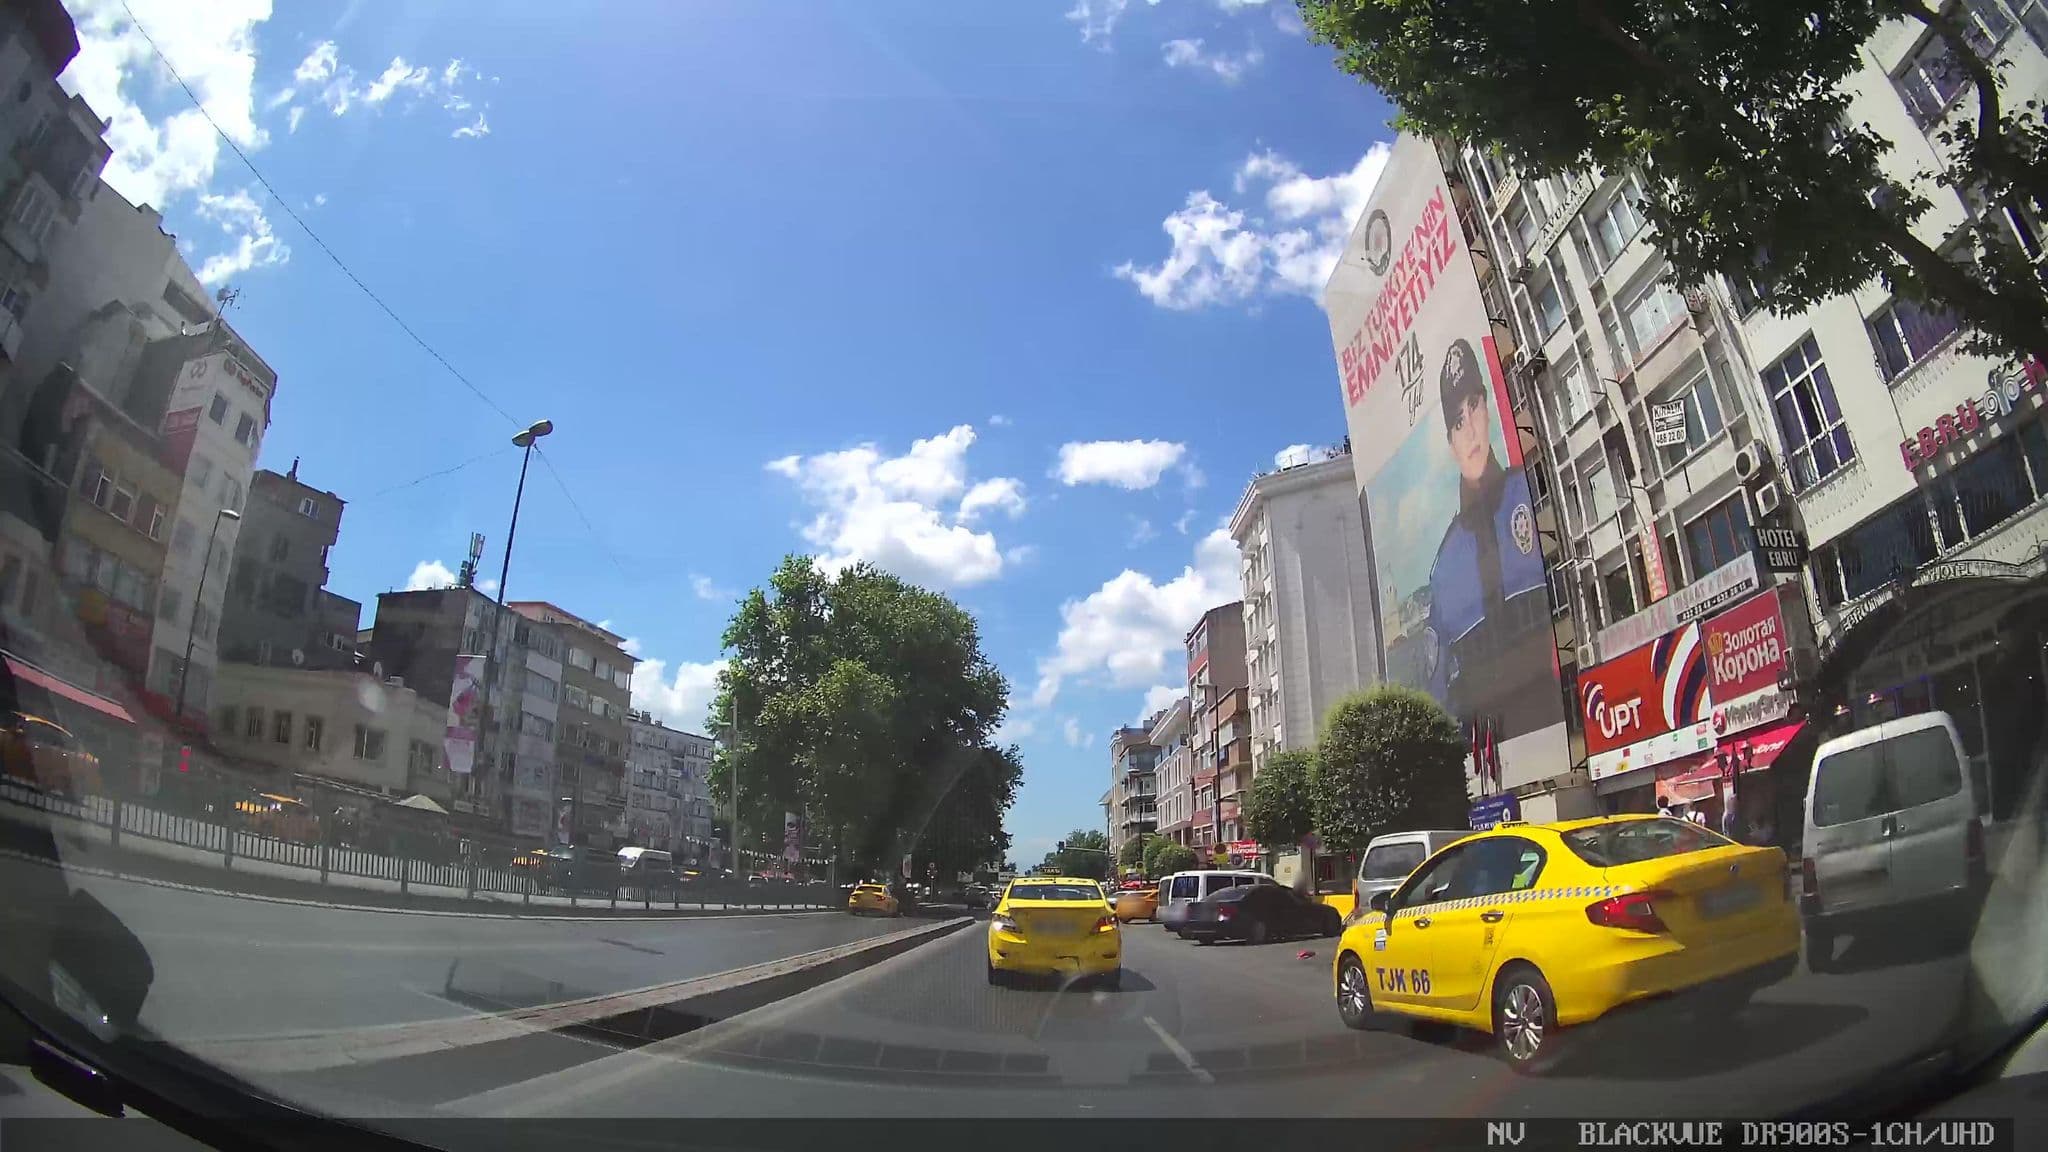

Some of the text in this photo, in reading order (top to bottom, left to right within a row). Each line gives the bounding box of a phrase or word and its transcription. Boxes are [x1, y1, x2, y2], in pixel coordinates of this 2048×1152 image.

[1543, 177, 1584, 240] AVUKAT
[1345, 213, 1456, 409] EMNİYETİYİZ
[1900, 397, 1979, 472] EBRU
[1757, 528, 1799, 548] HOTEL
[1768, 551, 1798, 567] EBRU
[1723, 616, 1776, 653] Золотая
[1712, 637, 1780, 686] Корона
[1597, 697, 1642, 739] UPT
[1376, 967, 1431, 995] TJK 66
